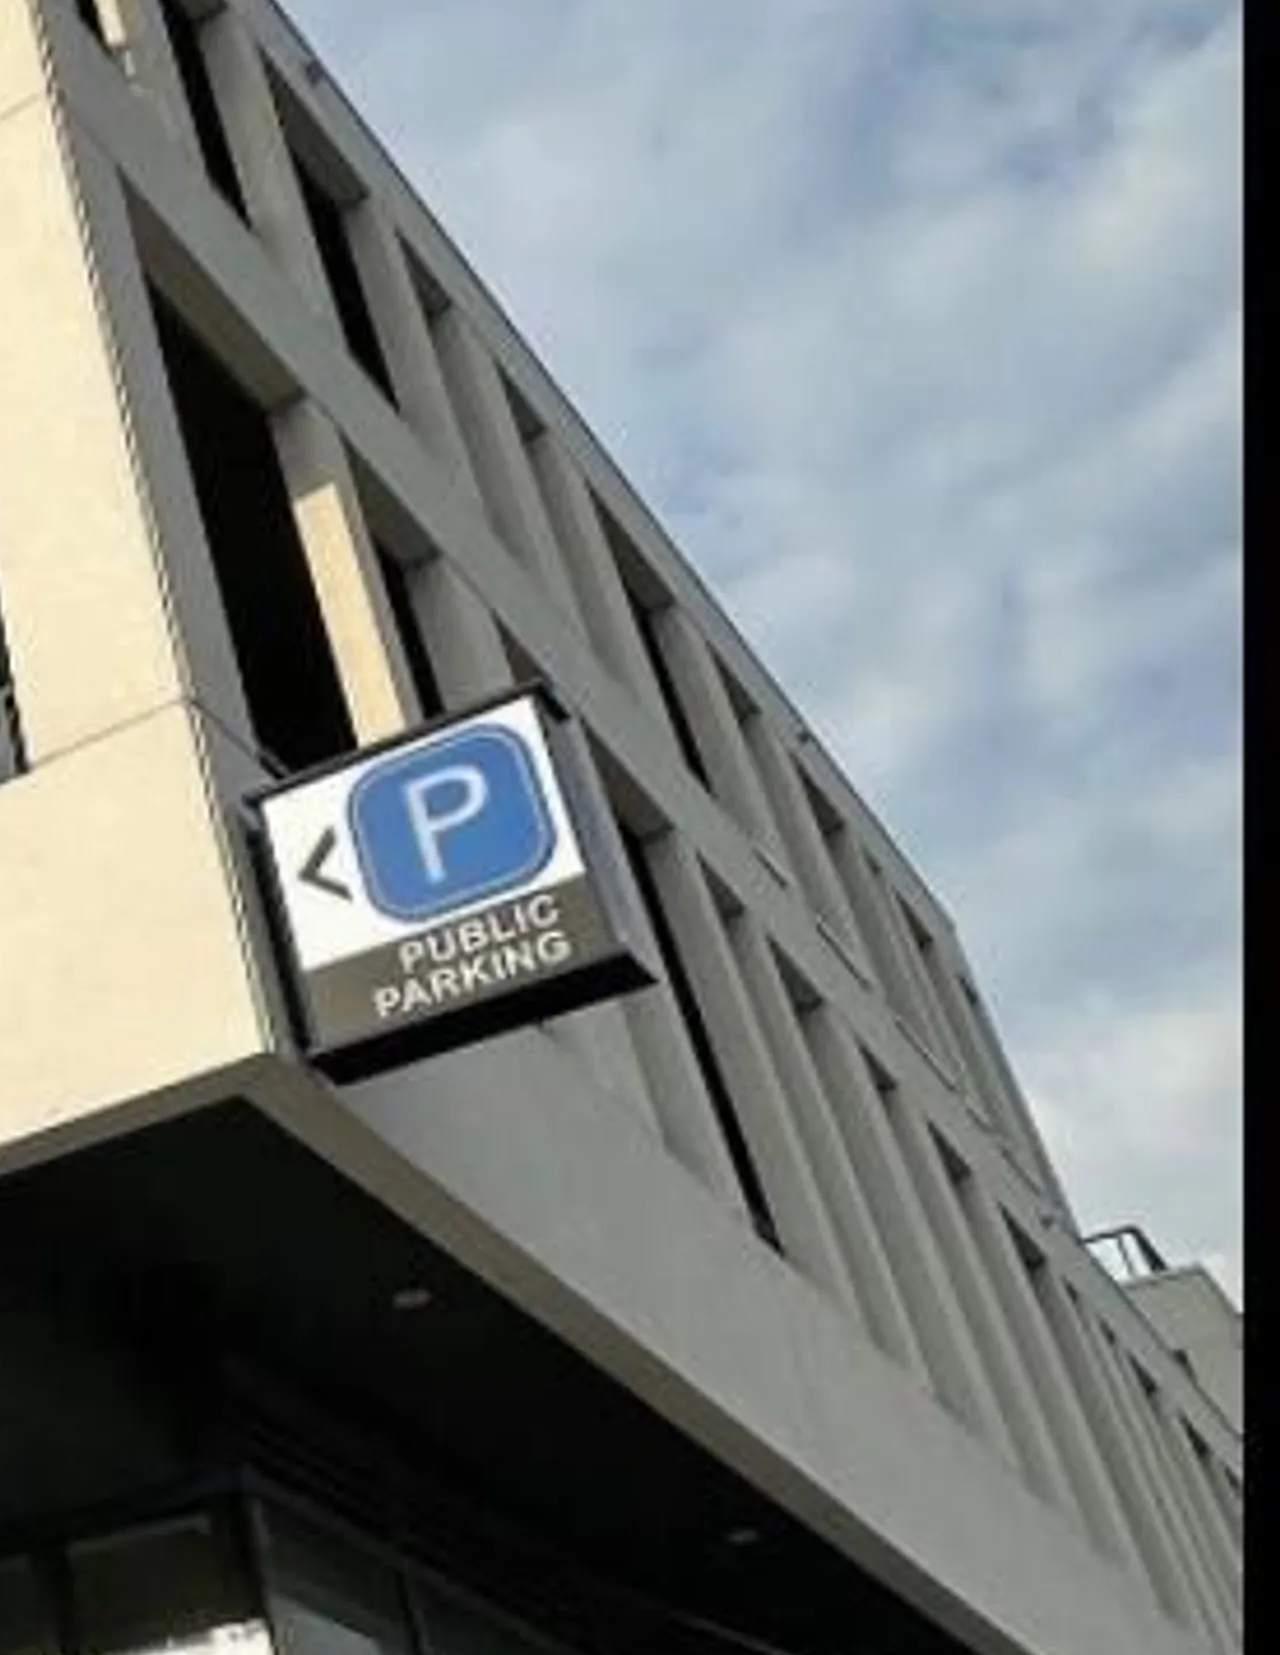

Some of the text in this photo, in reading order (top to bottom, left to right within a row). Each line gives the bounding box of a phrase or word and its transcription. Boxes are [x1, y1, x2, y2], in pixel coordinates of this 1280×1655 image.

[402, 763, 488, 883] P
[372, 930, 572, 1019] PARKING
[398, 893, 561, 974] PUBLIC
